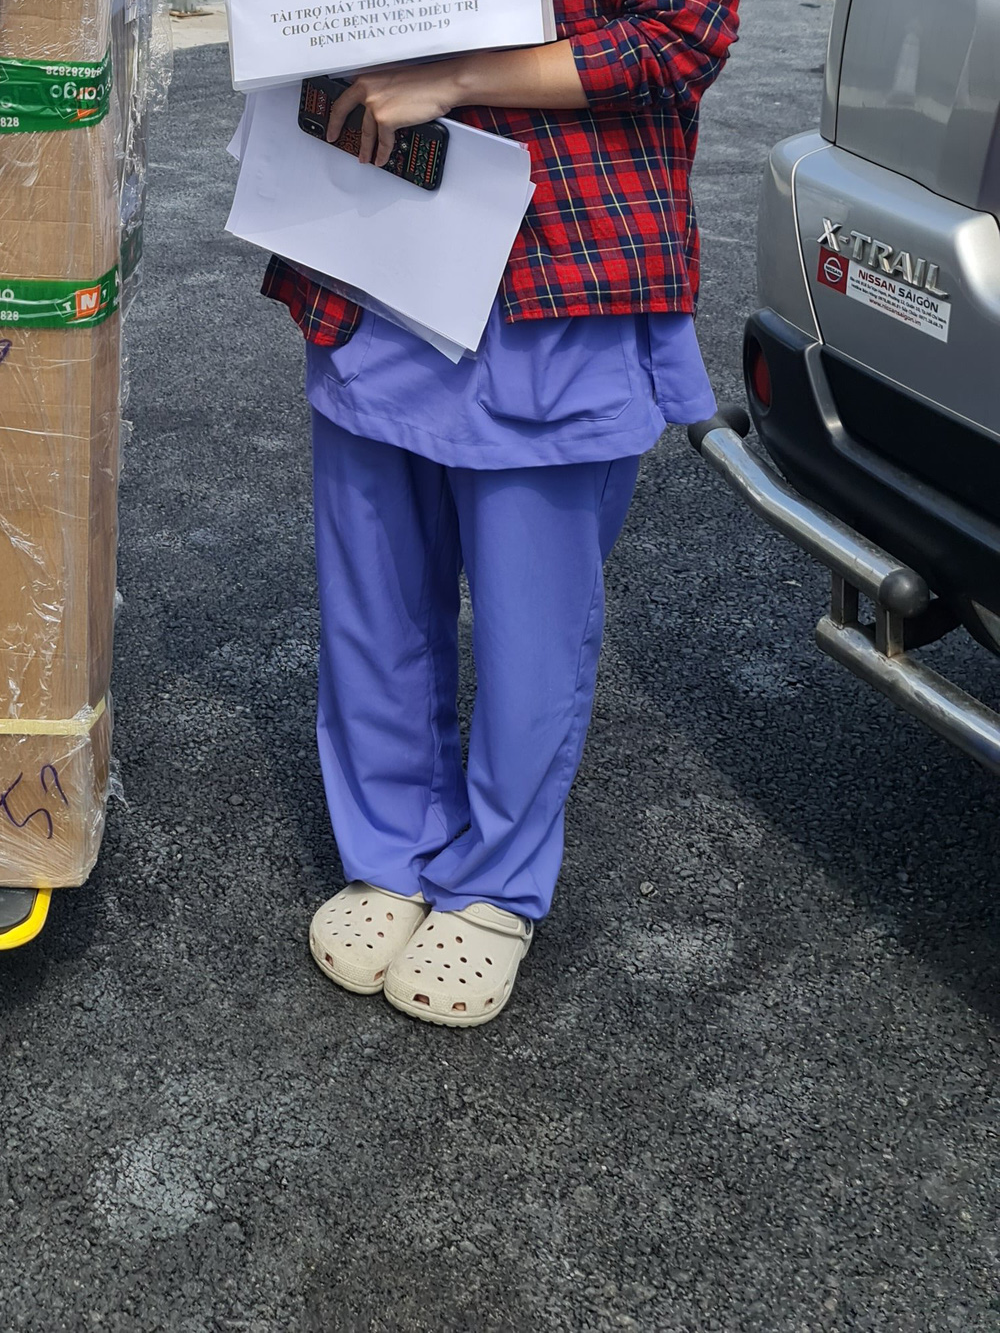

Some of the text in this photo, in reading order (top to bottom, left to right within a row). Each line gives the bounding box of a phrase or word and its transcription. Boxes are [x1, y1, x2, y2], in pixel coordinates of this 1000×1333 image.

[270, 9, 292, 23] TÀI
[295, 5, 322, 19] TRỢ
[325, 0, 355, 15] MÁY
[282, 23, 310, 36] CHO
[313, 17, 340, 32] CÁC
[343, 13, 379, 28] BỆNH
[382, 8, 415, 22] VIỆN
[454, 0, 479, 12] TRỊ
[310, 18, 451, 48] BỆNH NHÂN COVID-19
[817, 217, 949, 299] X-TRAIL
[825, 265, 843, 277] NISSAN
[858, 269, 896, 294] NISSAN
